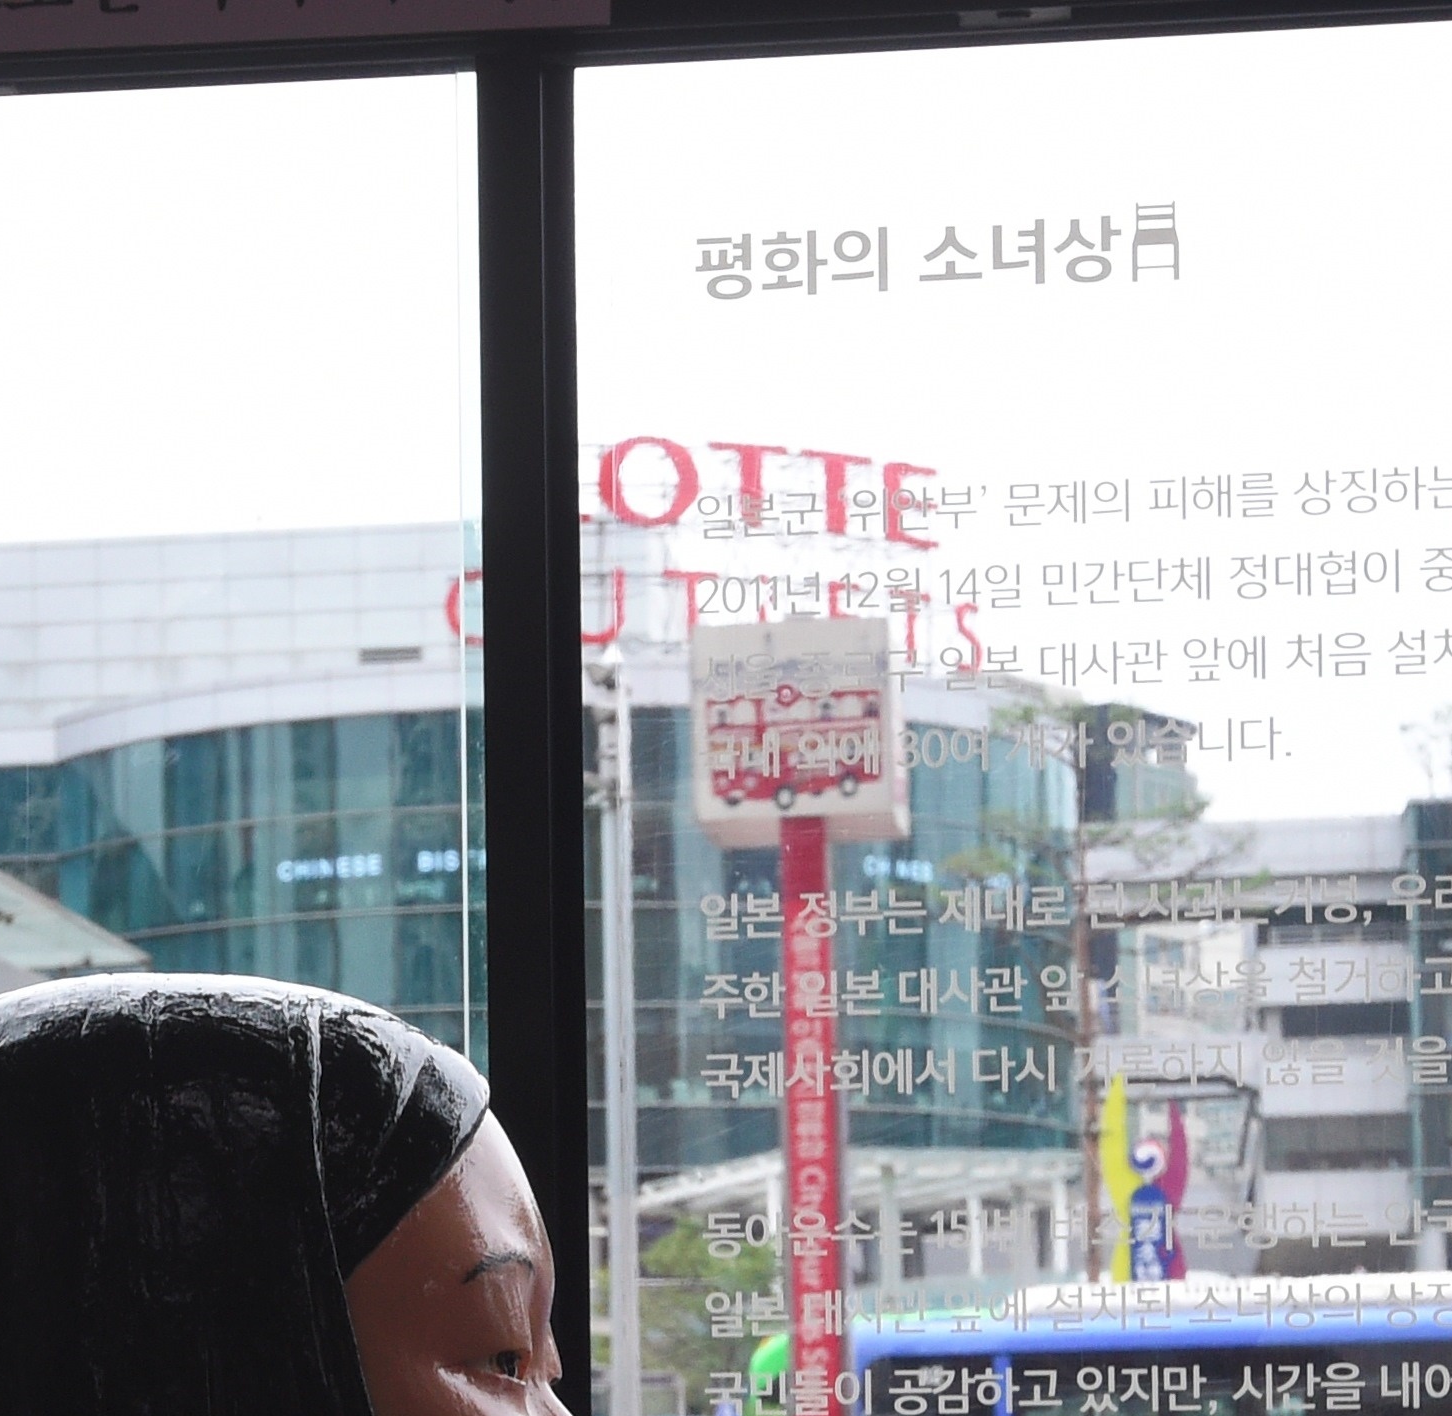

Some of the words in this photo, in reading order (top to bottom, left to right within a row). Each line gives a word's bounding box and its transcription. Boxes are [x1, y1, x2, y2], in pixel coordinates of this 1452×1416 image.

[695, 226, 888, 299] 평화의
[919, 215, 1121, 284] 소녀상
[579, 436, 940, 549] OTTE
[696, 490, 822, 540] 일본군
[1003, 478, 1131, 527] 문제의
[1149, 471, 1279, 520] 피해를
[698, 569, 822, 615] 2011년
[840, 566, 925, 614] 12월
[939, 563, 1022, 609] 14일
[1042, 556, 1211, 606] 민간단체
[1229, 548, 1401, 600] 정대협이
[939, 644, 1024, 692] 일본
[1041, 638, 1169, 687] 대사관
[1182, 635, 1268, 682] 앞에
[1286, 630, 1371, 677] 처음
[897, 724, 990, 772] 30여
[1007, 721, 1095, 769] 개가
[1107, 716, 1293, 767] 있습니다.
[700, 891, 785, 940] 일본
[797, 888, 928, 938] 정부는
[939, 884, 1072, 933] 제대로
[1086, 882, 1126, 930] 된
[700, 971, 784, 1020] 주한
[797, 969, 886, 1019] 일본
[899, 965, 1029, 1013] 대사관
[1041, 963, 1085, 1012] 앞
[700, 1049, 956, 1099] 국제사회에서
[972, 1045, 1057, 1094] 다시
[1075, 1041, 1244, 1091] 거론하지
[1261, 1039, 1350, 1088] 않을
[1365, 1034, 1452, 1083] 것을
[1193, 1198, 1369, 1249] 운행하는
[704, 1291, 790, 1341] 일본
[945, 1286, 1029, 1334] 앞에
[1047, 1284, 1172, 1334] 설치된
[1189, 1280, 1363, 1330] 소녀상의
[888, 1368, 1063, 1416] 공감하고
[1076, 1364, 1219, 1416] 있지만,
[1232, 1361, 1367, 1411] 시간을
